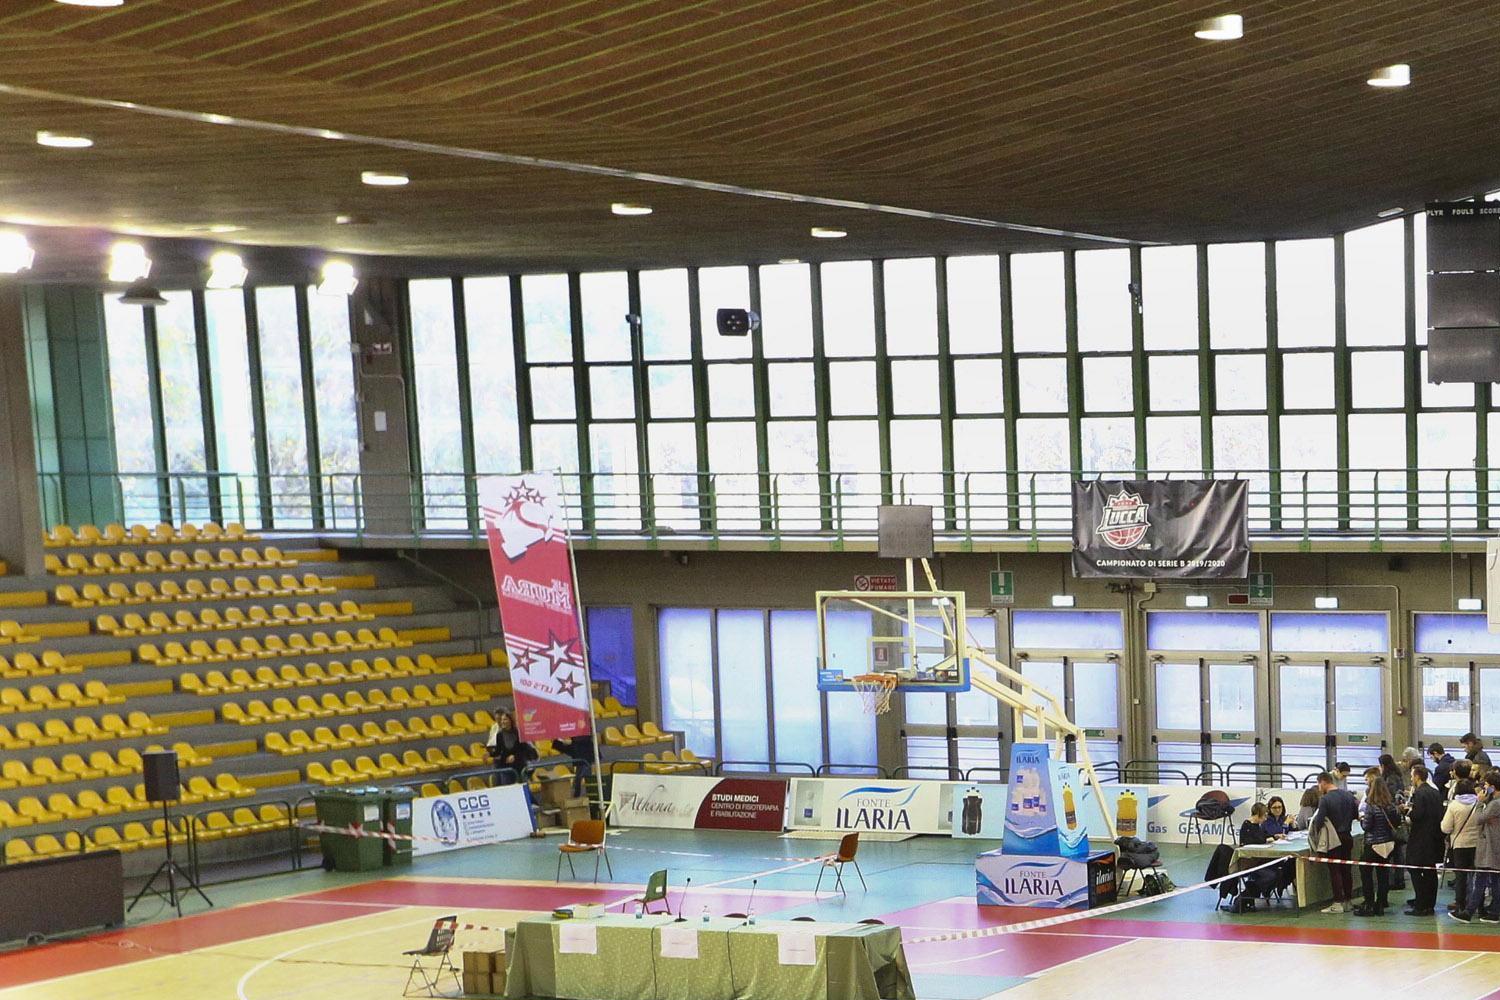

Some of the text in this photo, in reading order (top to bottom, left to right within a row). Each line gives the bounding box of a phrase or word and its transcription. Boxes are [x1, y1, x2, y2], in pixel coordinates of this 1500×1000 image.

[1099, 506, 1147, 531] LUCCA
[1016, 756, 1040, 764] ILARIA
[458, 795, 490, 810] CCG
[712, 794, 733, 802] STUDI
[856, 799, 891, 807] FONTE
[836, 807, 911, 830] ILARIA
[1147, 822, 1167, 833] Gas
[1179, 822, 1241, 836] GESAM Ga
[1019, 870, 1048, 879] FONTE
[1004, 878, 1064, 895] ILARIA
